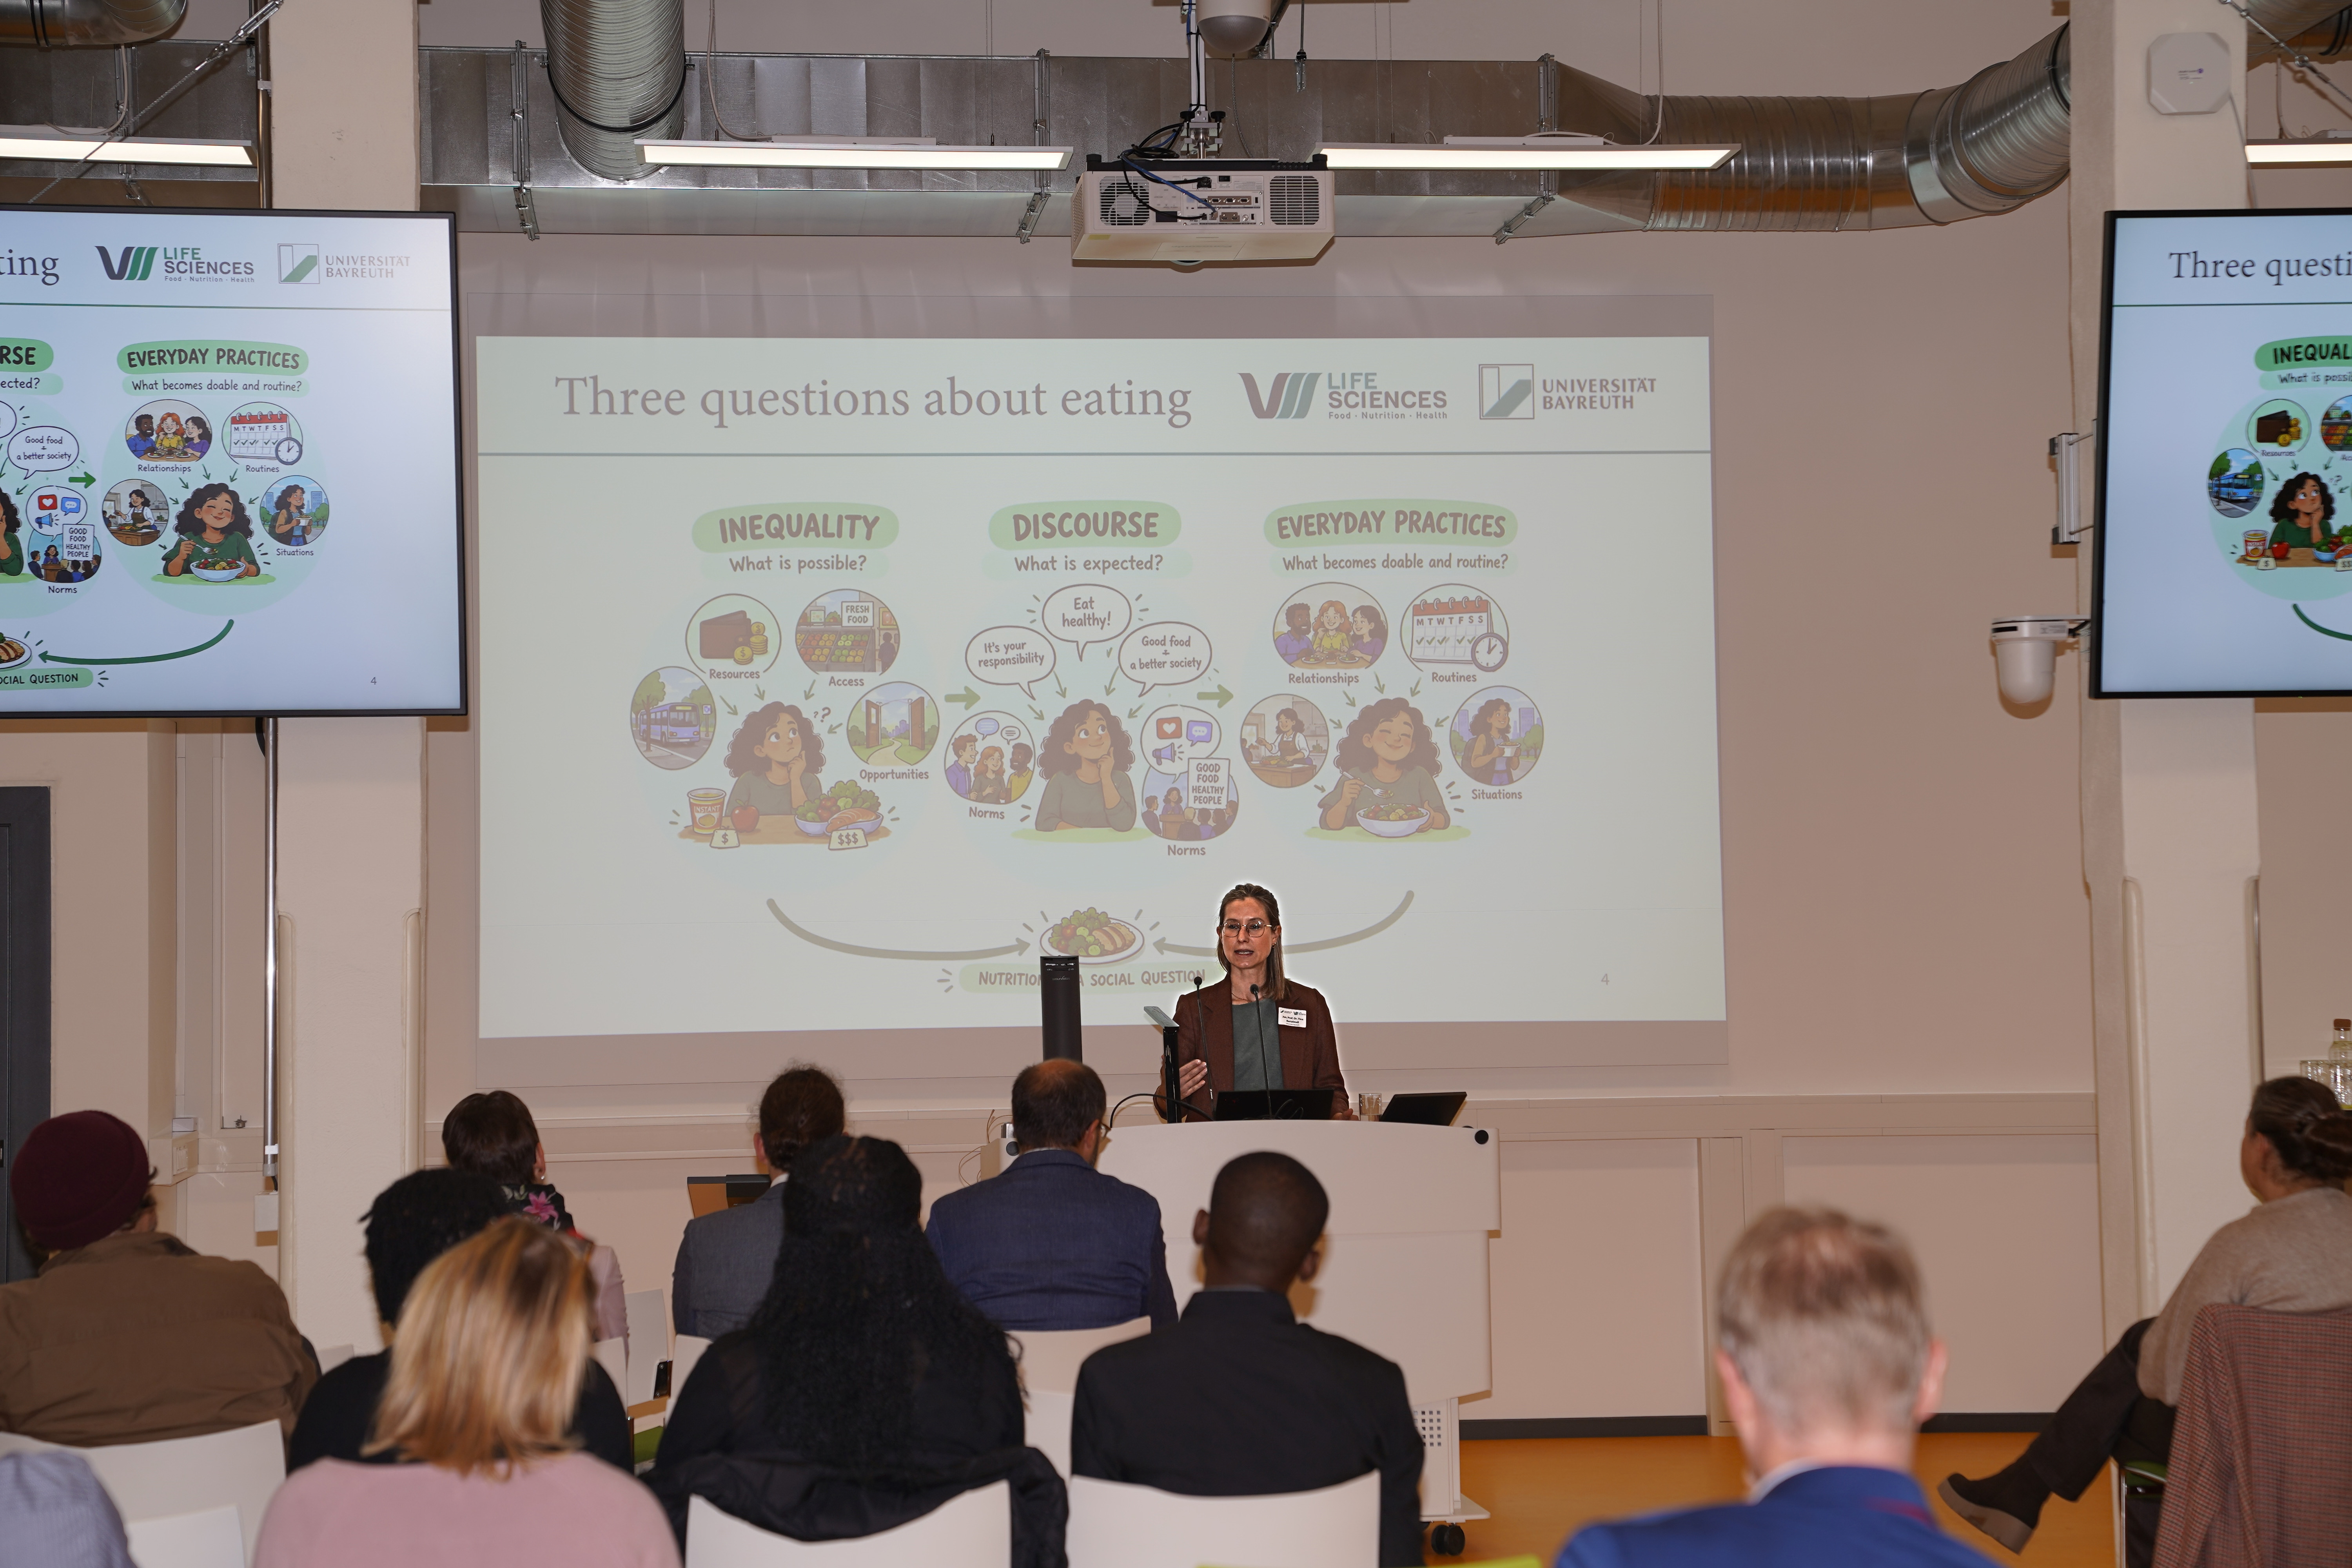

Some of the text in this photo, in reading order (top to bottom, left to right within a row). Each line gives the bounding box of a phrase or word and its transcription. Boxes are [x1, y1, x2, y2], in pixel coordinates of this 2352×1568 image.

[164, 247, 201, 260] LIFE
[326, 255, 410, 267] UNIVERSITÄT
[2169, 251, 2256, 278] Three
[164, 261, 254, 274] SCIENCES
[326, 267, 394, 278] BAYREUTH
[127, 348, 300, 369] EVERYDAY PRACTICES
[1328, 373, 1377, 390] LIFE
[2278, 373, 2308, 383] What
[2312, 372, 2321, 382] is
[132, 379, 301, 392] What becomes doable and routine?
[1542, 377, 1657, 393] UNIVERSITÄT
[555, 375, 1192, 428] Three questions about eating
[1328, 390, 1448, 409] SCIENCES
[1543, 395, 1634, 410] BAYREUTH
[46, 436, 63, 444] food
[47, 452, 71, 461] society
[138, 465, 191, 474] Relationships
[719, 513, 880, 543] INEQUALITY
[1013, 511, 1159, 541] DISCOURSE
[1277, 510, 1506, 539] EVERYDAY PRACTICES
[729, 554, 867, 574] What is possible?
[1014, 554, 1163, 575] What is expected?
[1283, 553, 1508, 571] What becomes doable and routine?
[846, 605, 869, 613] FRESH
[1074, 597, 1094, 610] Eat
[848, 615, 868, 624] FOOD
[1062, 611, 1111, 630] healthy!
[1459, 616, 1464, 624] F
[1478, 615, 1483, 623] S
[1004, 642, 1026, 652] your
[1142, 635, 1191, 647] Good food
[978, 652, 1044, 669] responsibility
[1138, 659, 1167, 669] better
[1170, 658, 1202, 670] society
[30, 673, 78, 684] QUESTION
[710, 669, 760, 679] Resources
[1289, 673, 1359, 686] Relationships
[1432, 672, 1477, 682] Routines
[829, 676, 864, 687] Access
[1196, 762, 1220, 773] GOOD
[860, 769, 929, 783] Opportunities
[1197, 773, 1220, 783] FOOD
[1192, 785, 1225, 795] HEALTHY
[1472, 789, 1523, 800] Situations
[1193, 795, 1222, 806] PEOPLE
[693, 805, 720, 813] INSTANT
[969, 807, 1005, 820] Norms
[1167, 845, 1206, 856] Norms
[1091, 973, 1135, 987] SOCIAL
[1141, 969, 1205, 985] QUESTION
[1601, 973, 1609, 985] 4
